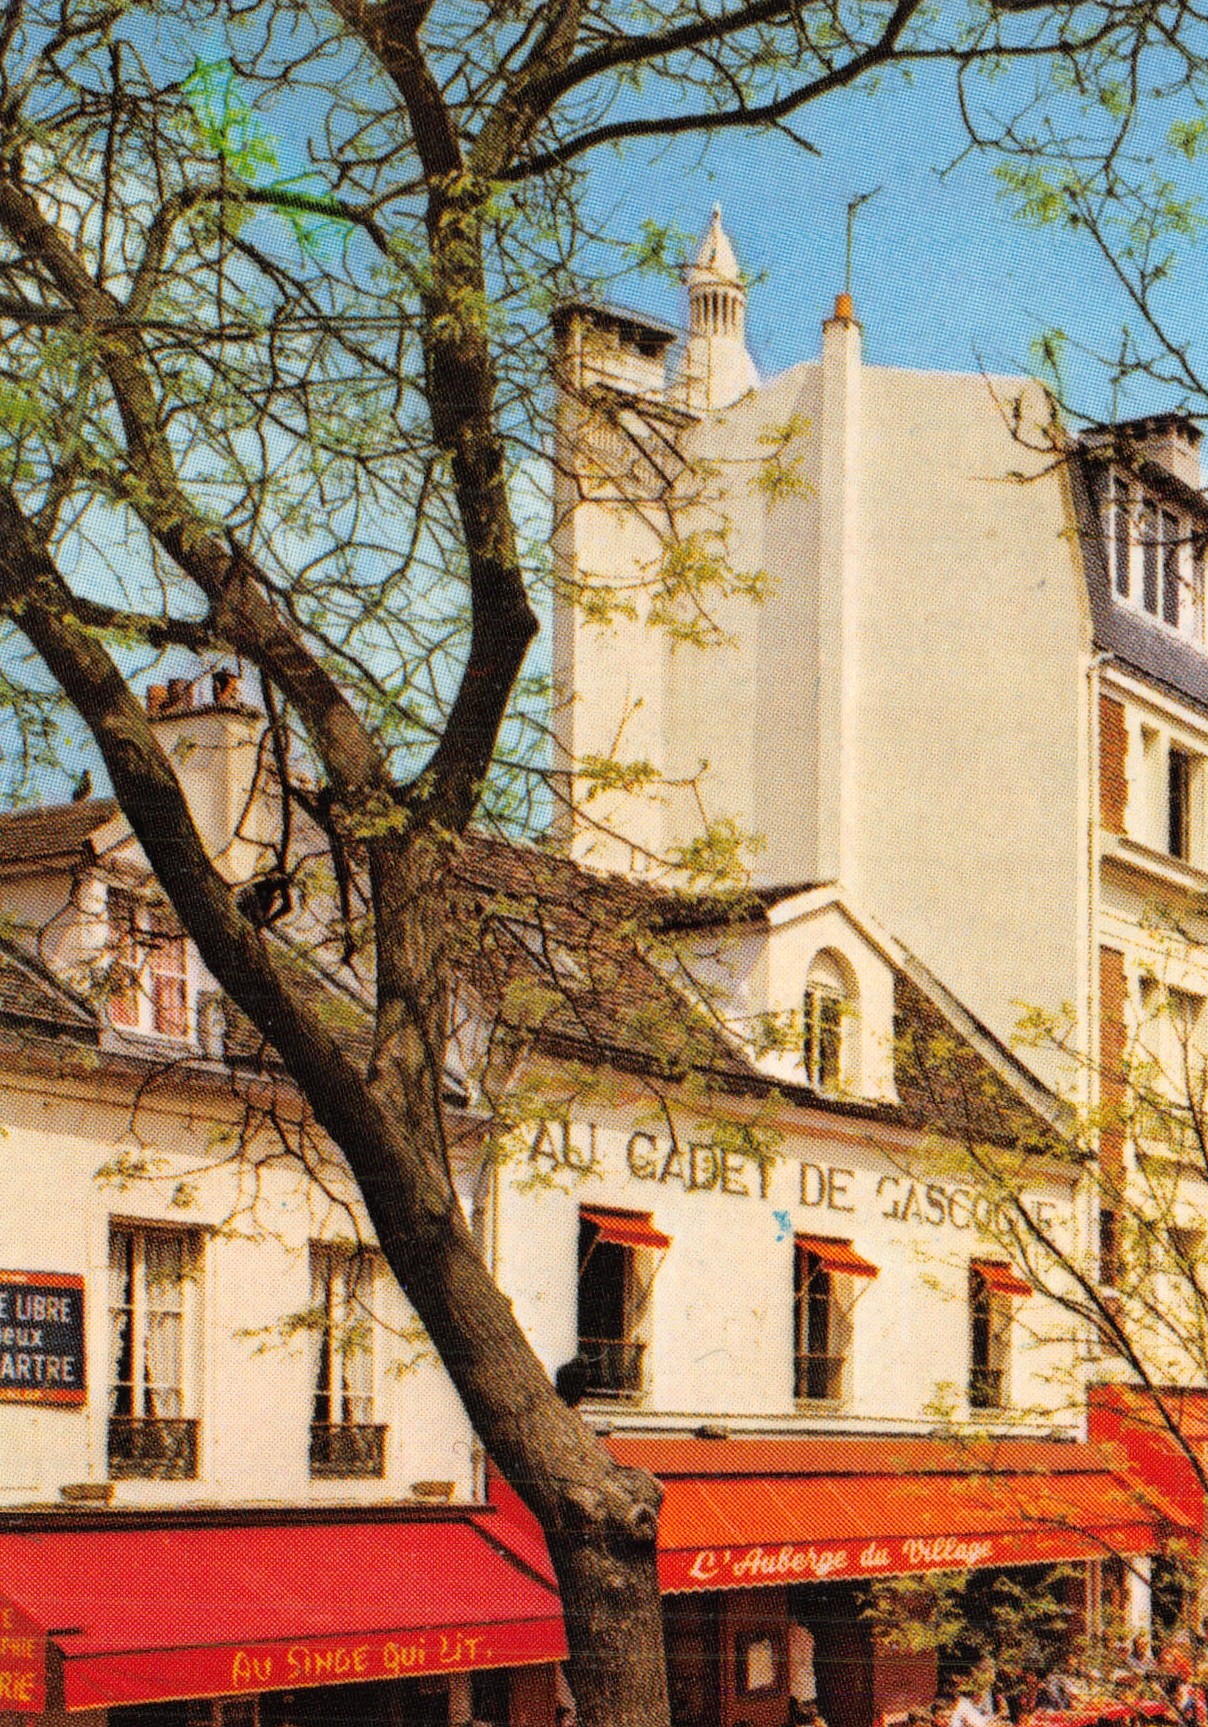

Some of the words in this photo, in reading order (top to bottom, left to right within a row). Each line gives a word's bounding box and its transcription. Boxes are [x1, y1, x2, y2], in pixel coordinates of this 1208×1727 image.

[527, 1119, 597, 1172] AU
[626, 1131, 777, 1199] CADET
[800, 1163, 855, 1212] DE
[15, 1292, 72, 1322] LIBRE
[689, 1547, 847, 1580] L'Auberge
[860, 1541, 891, 1567] du
[903, 1537, 993, 1566] Village
[232, 1650, 272, 1687] AU
